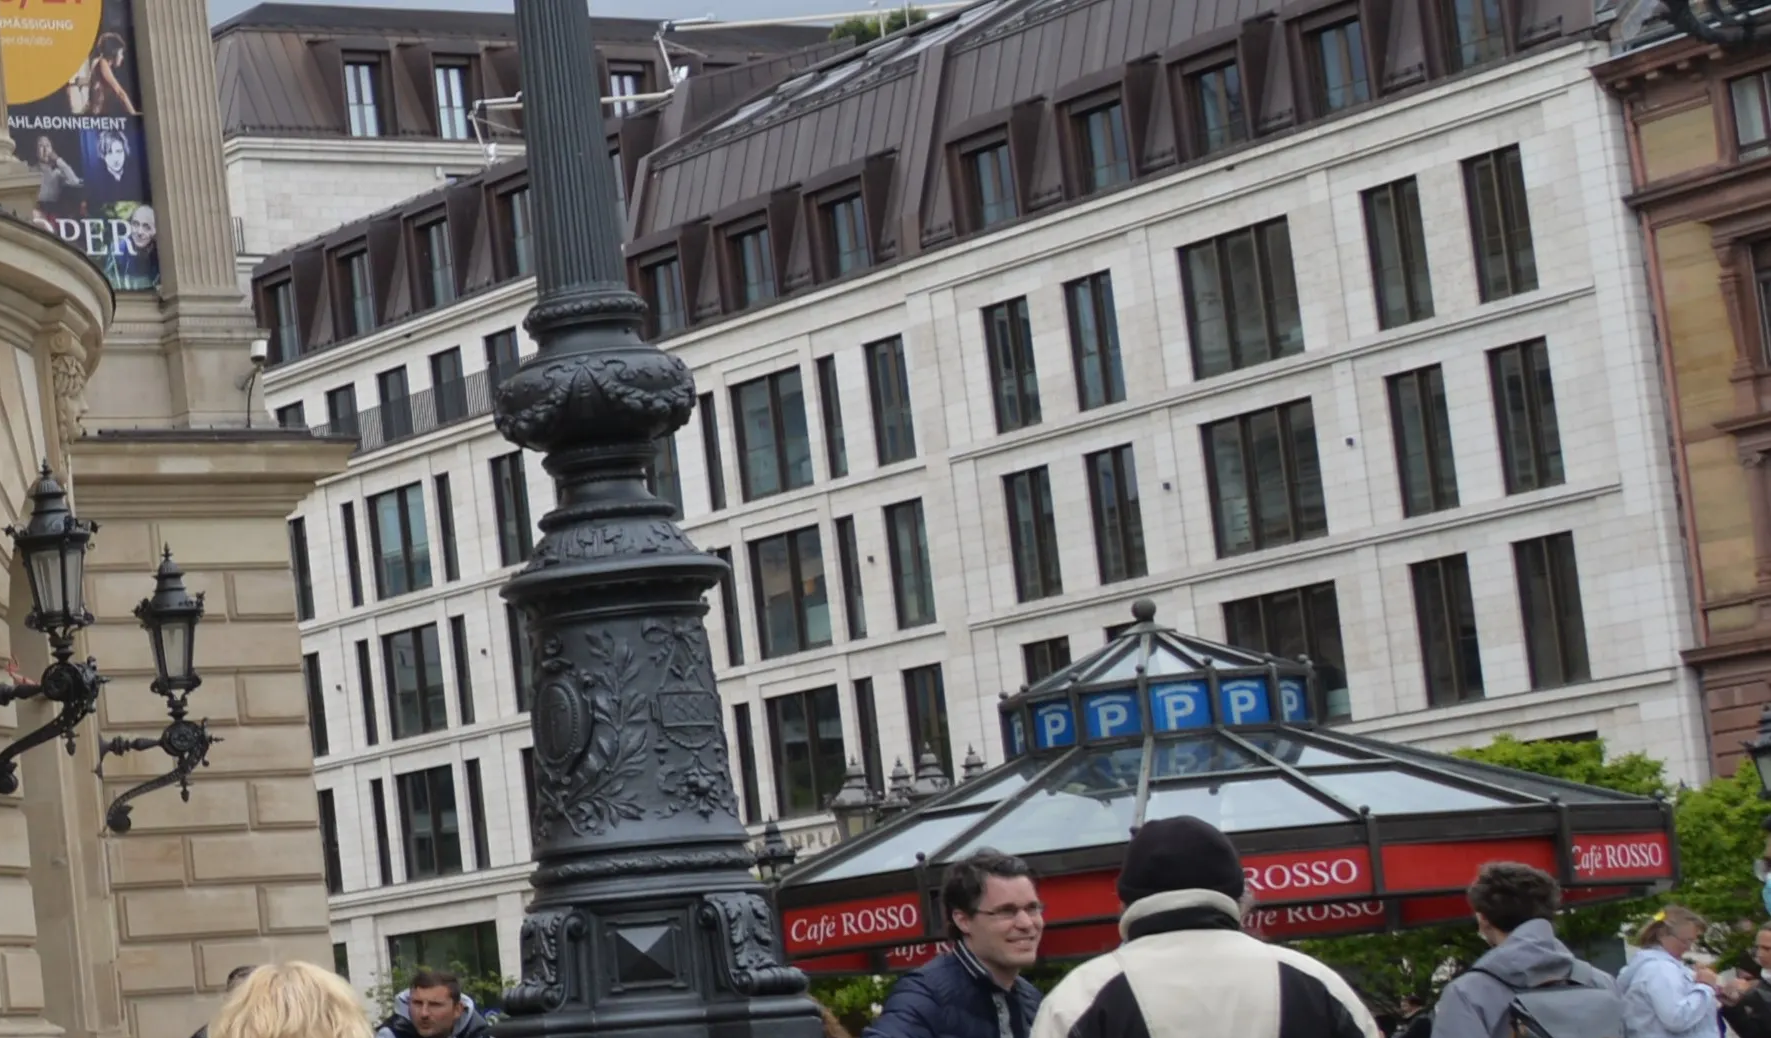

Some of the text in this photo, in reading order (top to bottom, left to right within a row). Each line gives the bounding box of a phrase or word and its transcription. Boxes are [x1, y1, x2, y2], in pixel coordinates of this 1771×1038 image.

[8, 115, 127, 131] AHLABONNEMENT
[1097, 703, 1128, 738] P
[1164, 694, 1196, 731] P
[1229, 689, 1256, 725] P
[1281, 688, 1299, 723] P
[1043, 711, 1067, 748] P
[1605, 842, 1662, 869] ROSSO
[790, 903, 917, 945] Café ROSSO
